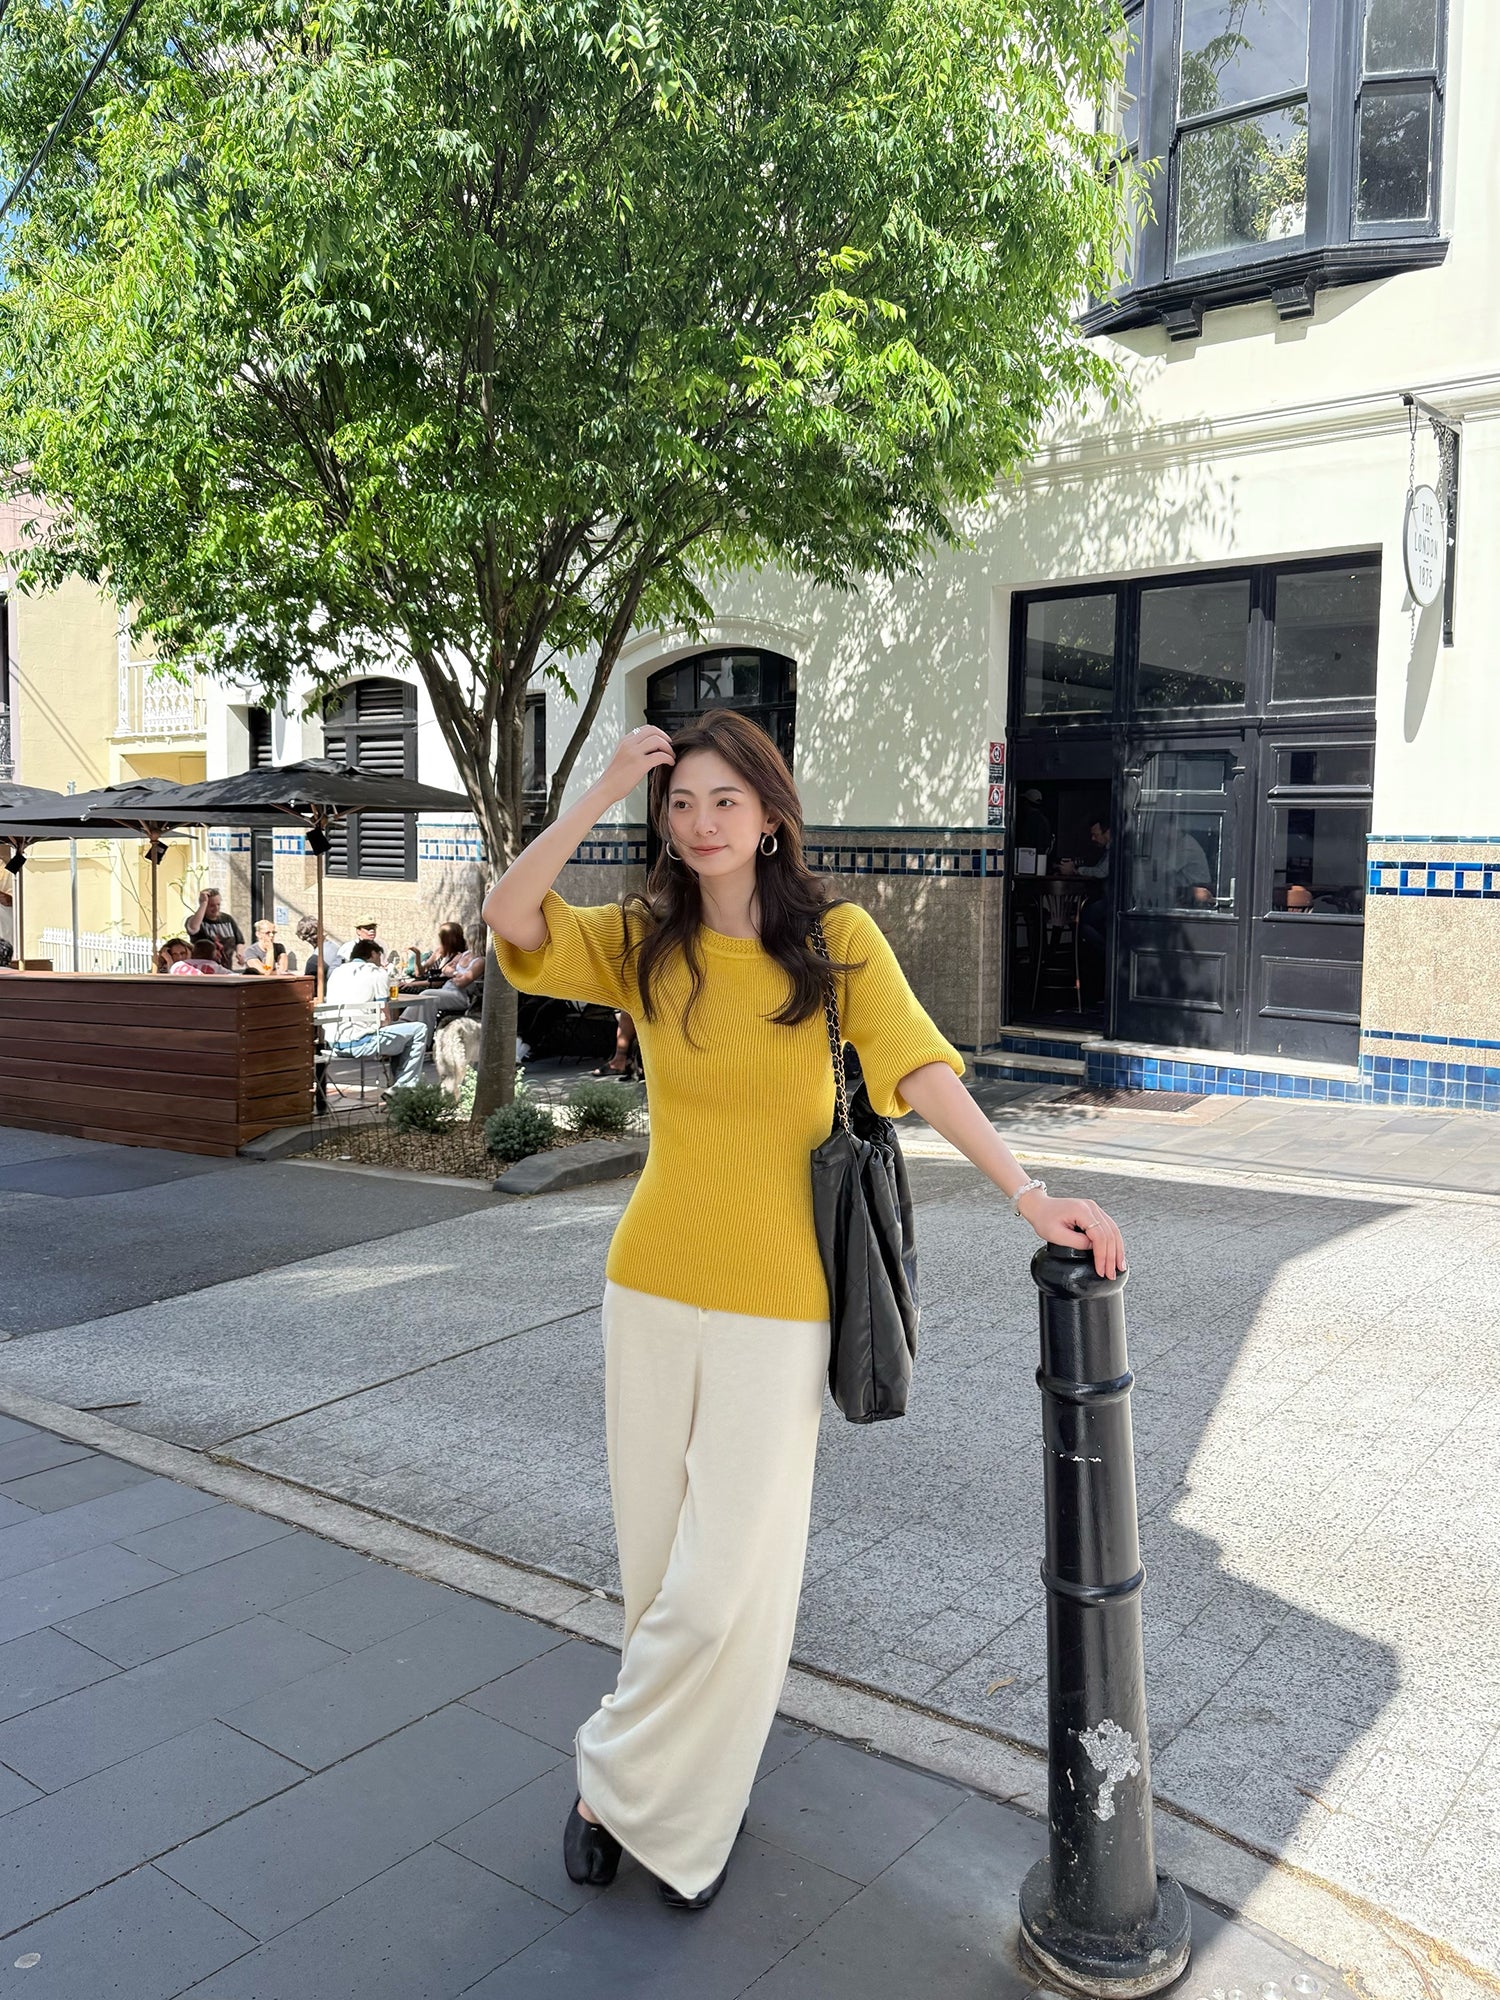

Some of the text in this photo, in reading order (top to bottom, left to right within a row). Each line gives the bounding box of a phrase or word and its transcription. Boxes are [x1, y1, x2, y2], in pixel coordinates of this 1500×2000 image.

[1422, 503, 1433, 526] THE
[1414, 531, 1438, 560] LONDON
[1418, 565, 1433, 588] 1875
